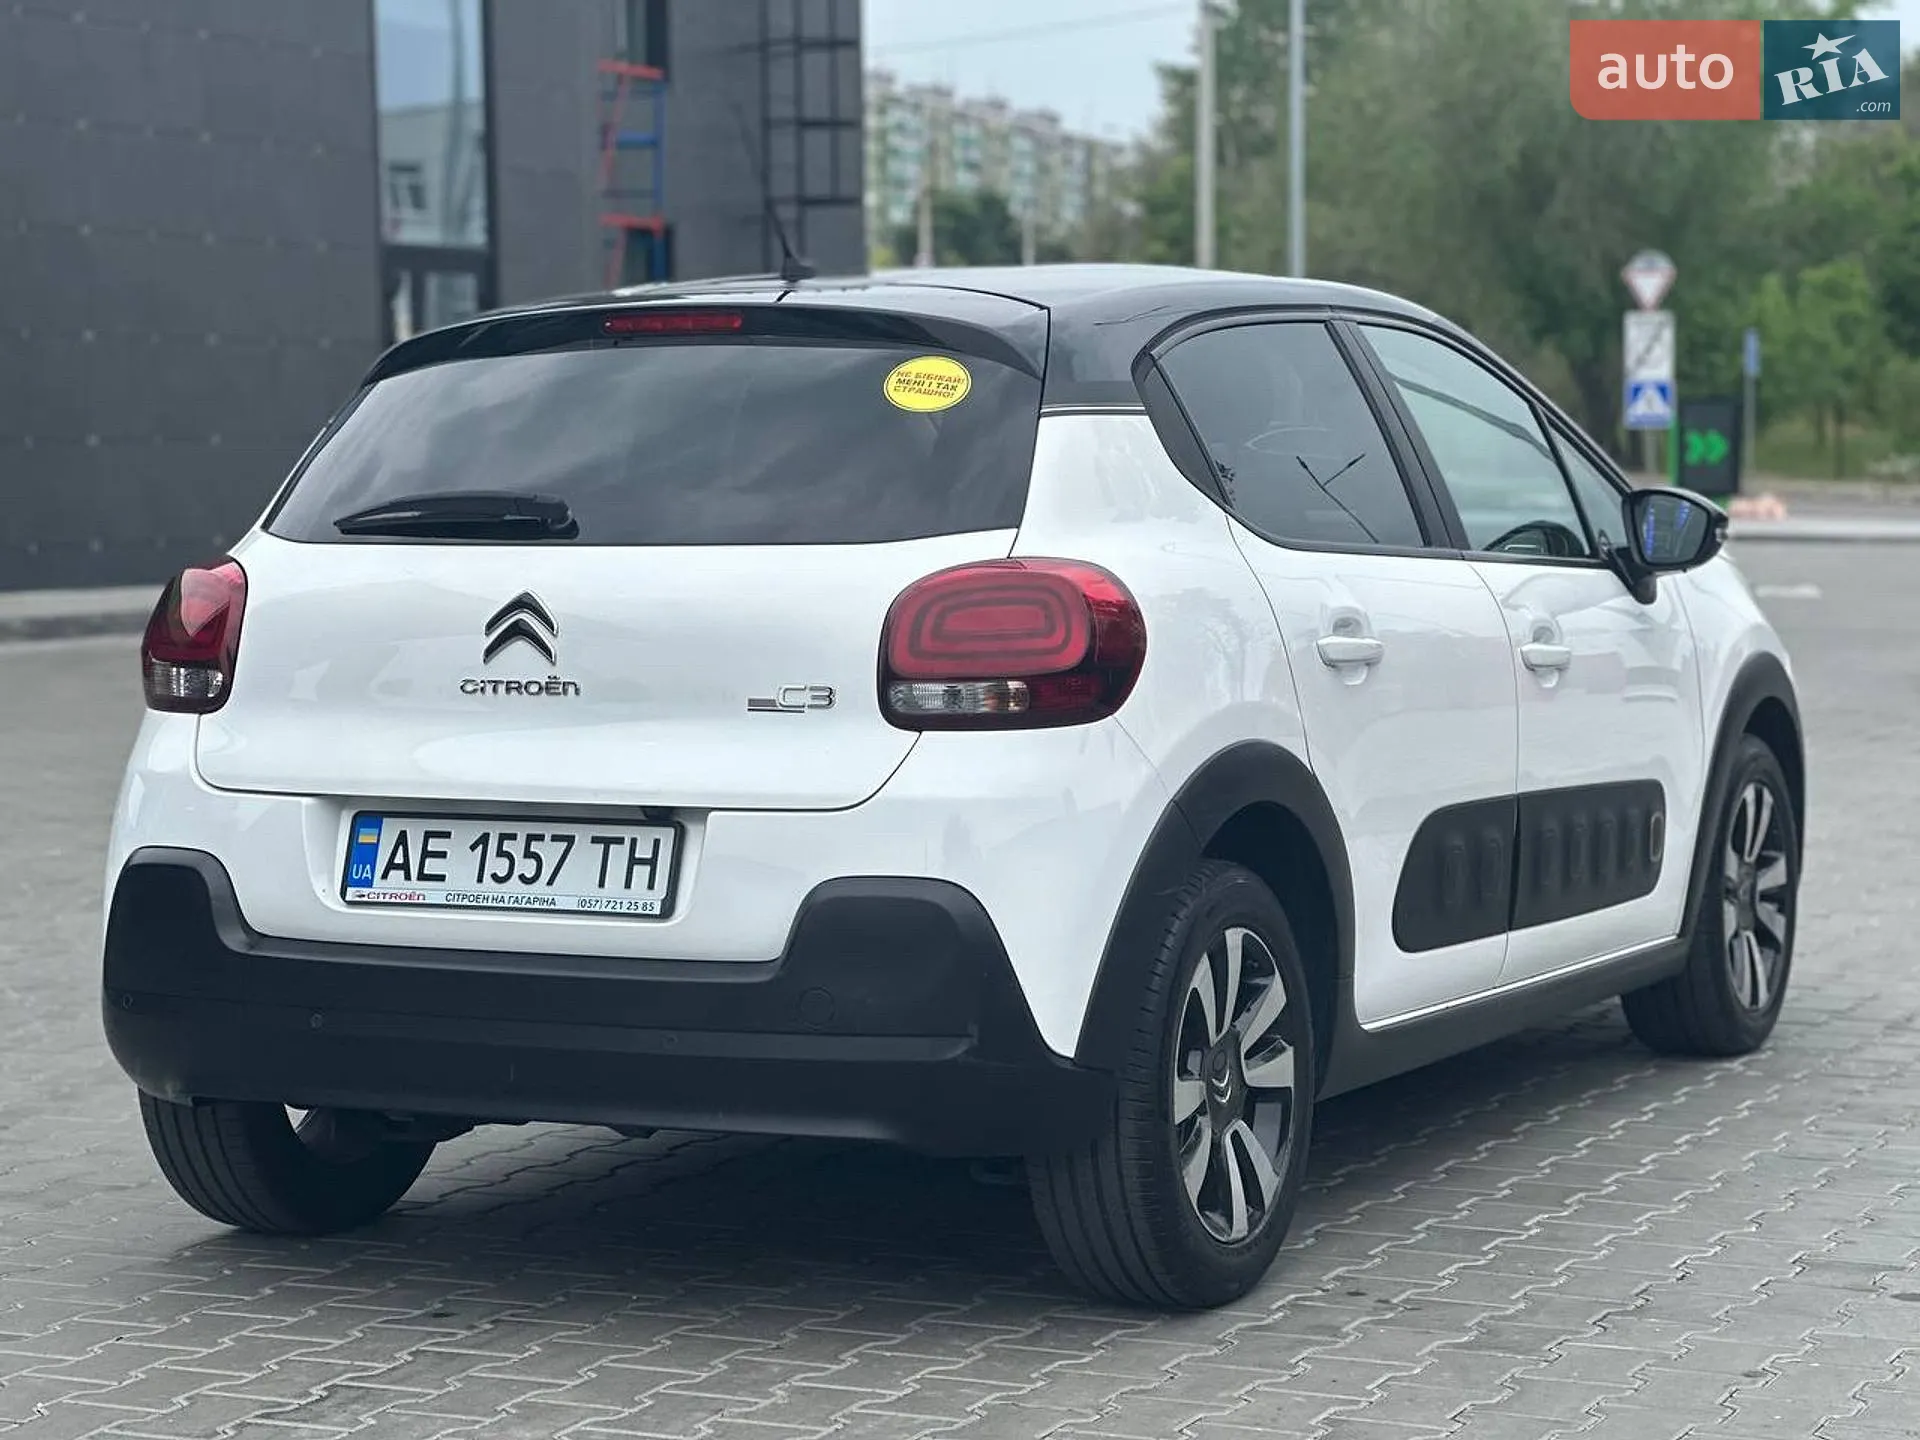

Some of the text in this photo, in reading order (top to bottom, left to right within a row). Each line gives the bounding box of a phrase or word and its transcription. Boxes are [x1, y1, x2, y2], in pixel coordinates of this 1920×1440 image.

[893, 385, 955, 398] СТРАШНО!
[895, 378, 924, 387] МЕНІ
[936, 382, 958, 391] ТАК
[779, 684, 836, 710] C3
[381, 829, 661, 891] AE 1557 TH
[352, 864, 372, 881] UA
[491, 894, 505, 904] НА
[507, 895, 557, 907] ГАГАРІНА
[577, 898, 655, 912] (057) 721 25 85
